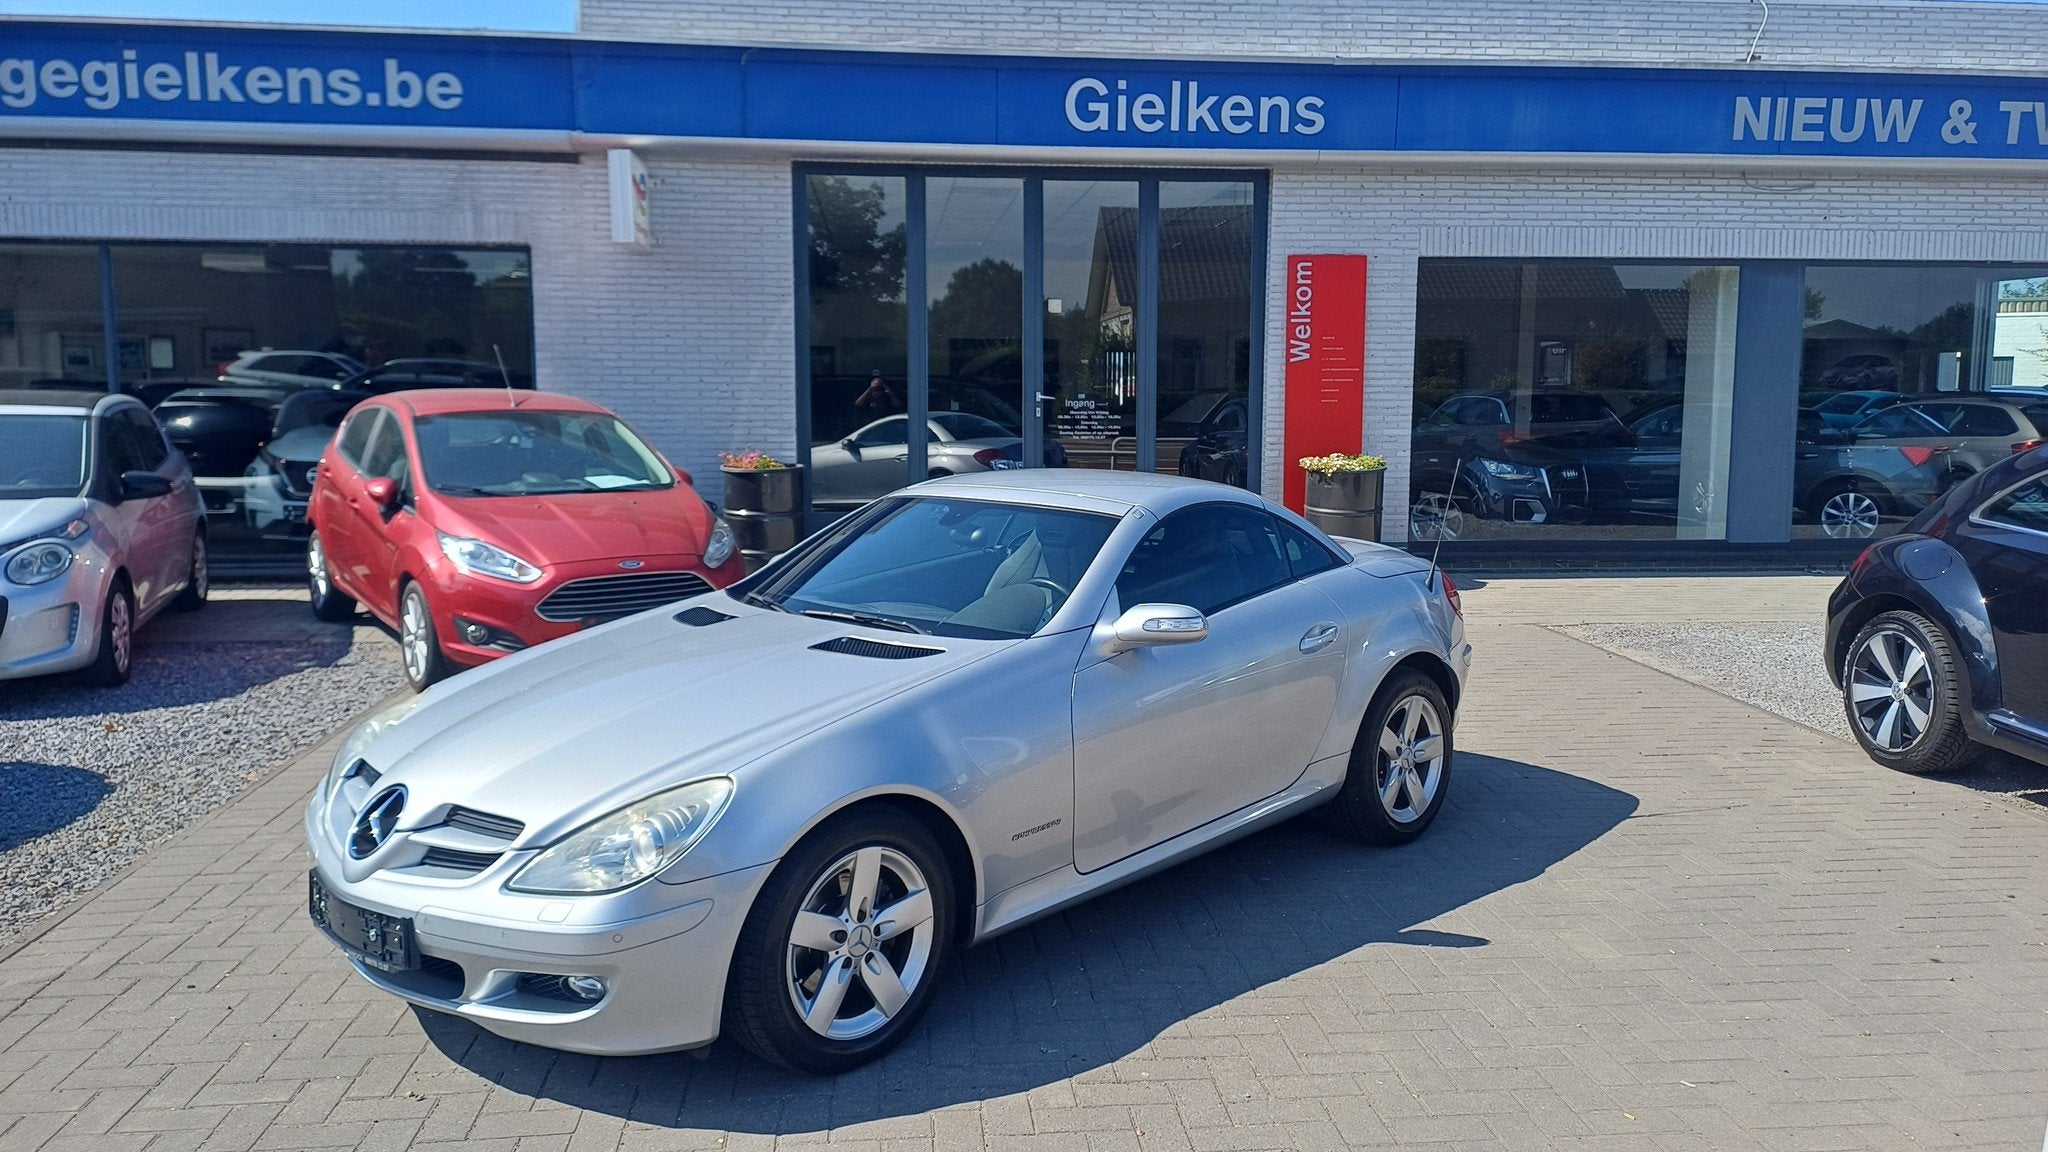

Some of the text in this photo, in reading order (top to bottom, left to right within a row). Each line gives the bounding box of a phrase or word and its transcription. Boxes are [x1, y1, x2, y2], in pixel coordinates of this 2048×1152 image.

[0, 49, 464, 110] gegielkens.be
[1064, 77, 1325, 136] Gielkens
[1732, 96, 1923, 143] NIEUW
[1941, 99, 1978, 144] &
[1289, 261, 1313, 363] Welkom
[1065, 399, 1095, 409] Ingang
